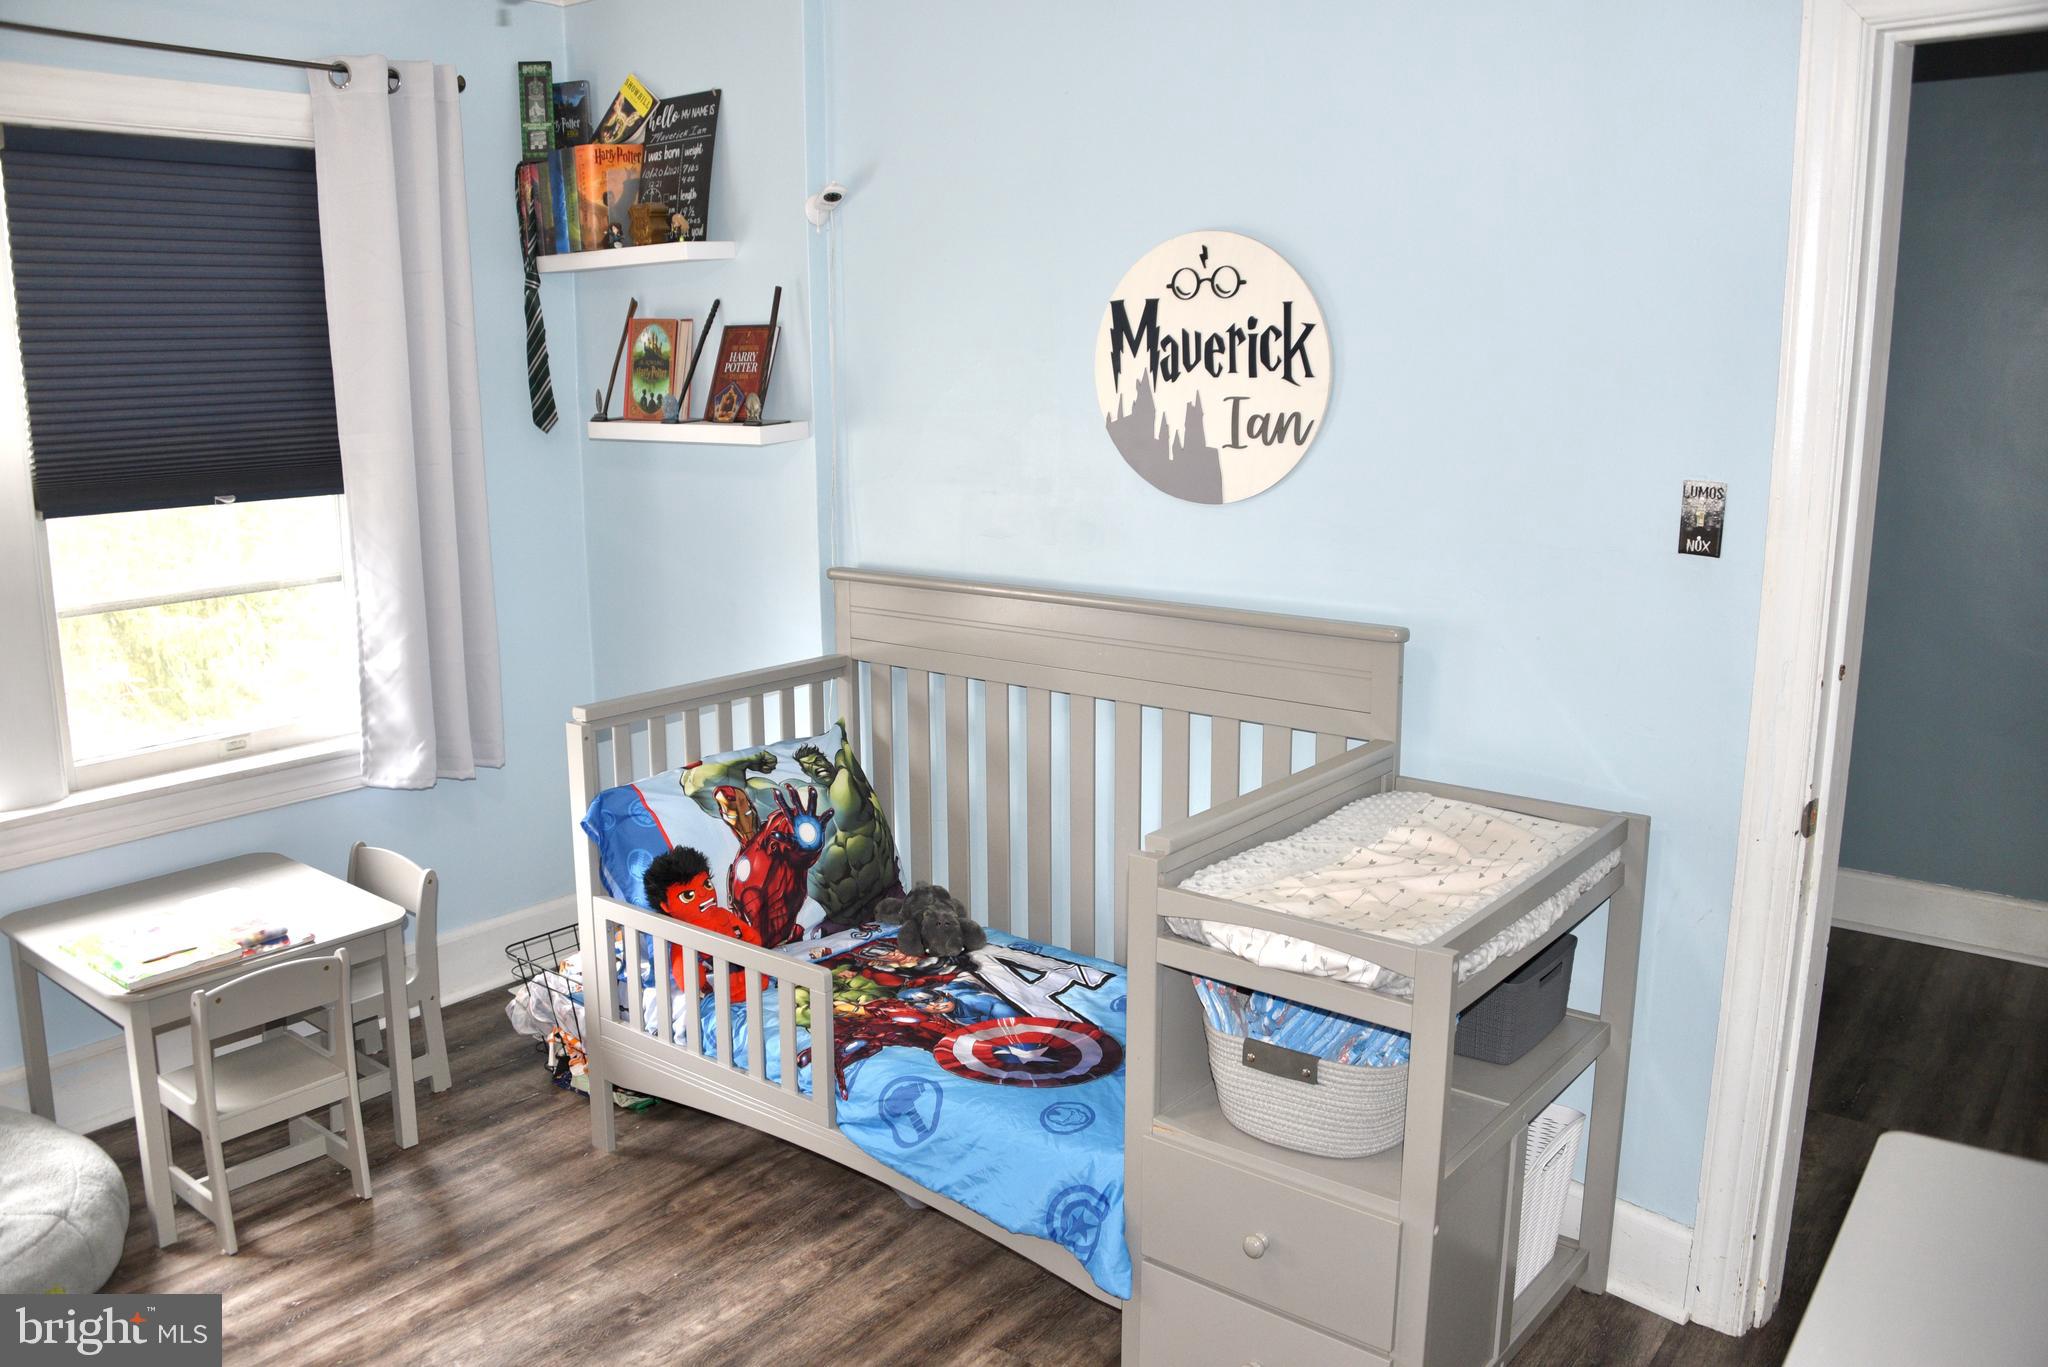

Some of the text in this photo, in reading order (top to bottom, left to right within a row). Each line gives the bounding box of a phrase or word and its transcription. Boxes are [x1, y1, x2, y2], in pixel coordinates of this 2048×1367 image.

[624, 77, 650, 109] SHOWBILL
[561, 117, 580, 134] Potter
[648, 104, 680, 131] hello
[692, 105, 708, 118] NAME
[594, 146, 641, 165] Harry Potter
[648, 150, 663, 162] was
[664, 145, 680, 160] born
[1110, 297, 1316, 393] Maverick
[729, 351, 758, 362] HARRY
[724, 362, 758, 373] POTTER
[1221, 396, 1315, 450] Ian
[1683, 485, 1725, 500] LUMOS
[1686, 538, 1711, 553] NOX
